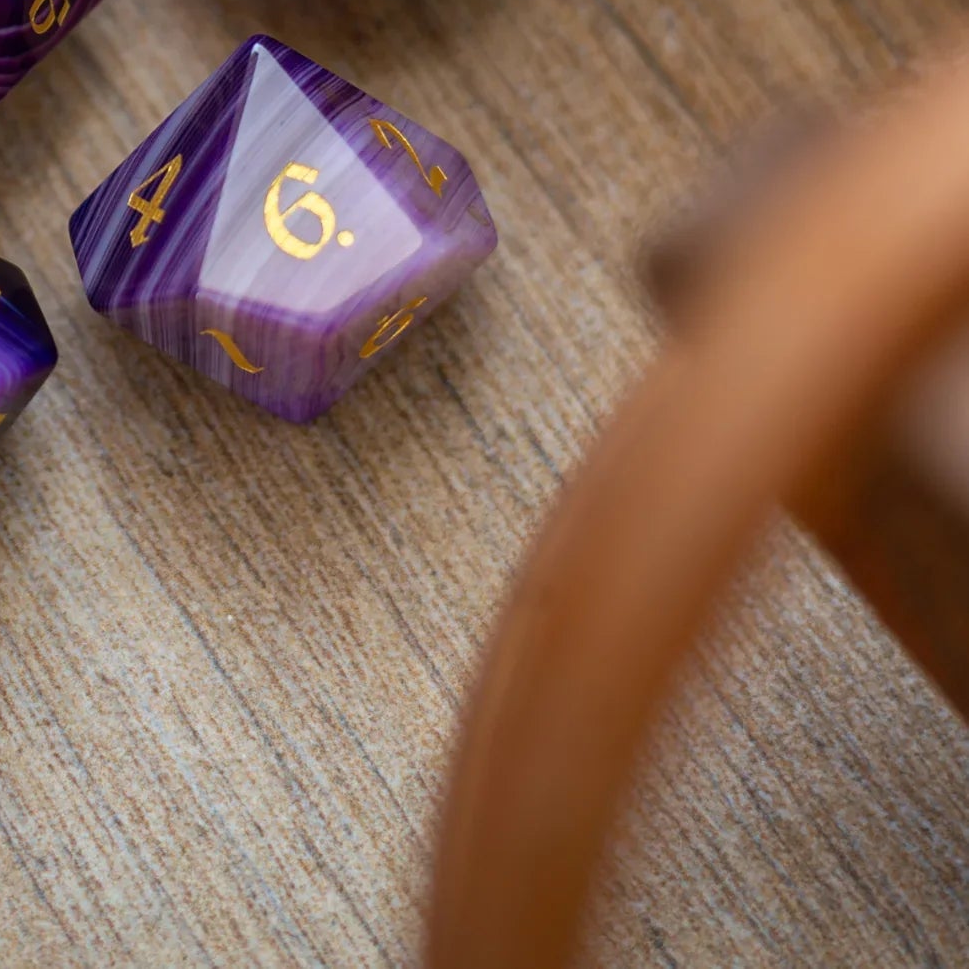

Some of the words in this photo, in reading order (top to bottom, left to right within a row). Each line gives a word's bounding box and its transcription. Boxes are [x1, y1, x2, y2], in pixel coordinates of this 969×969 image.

[367, 118, 449, 199] 2
[127, 153, 183, 248] 4
[199, 328, 265, 374] 1
